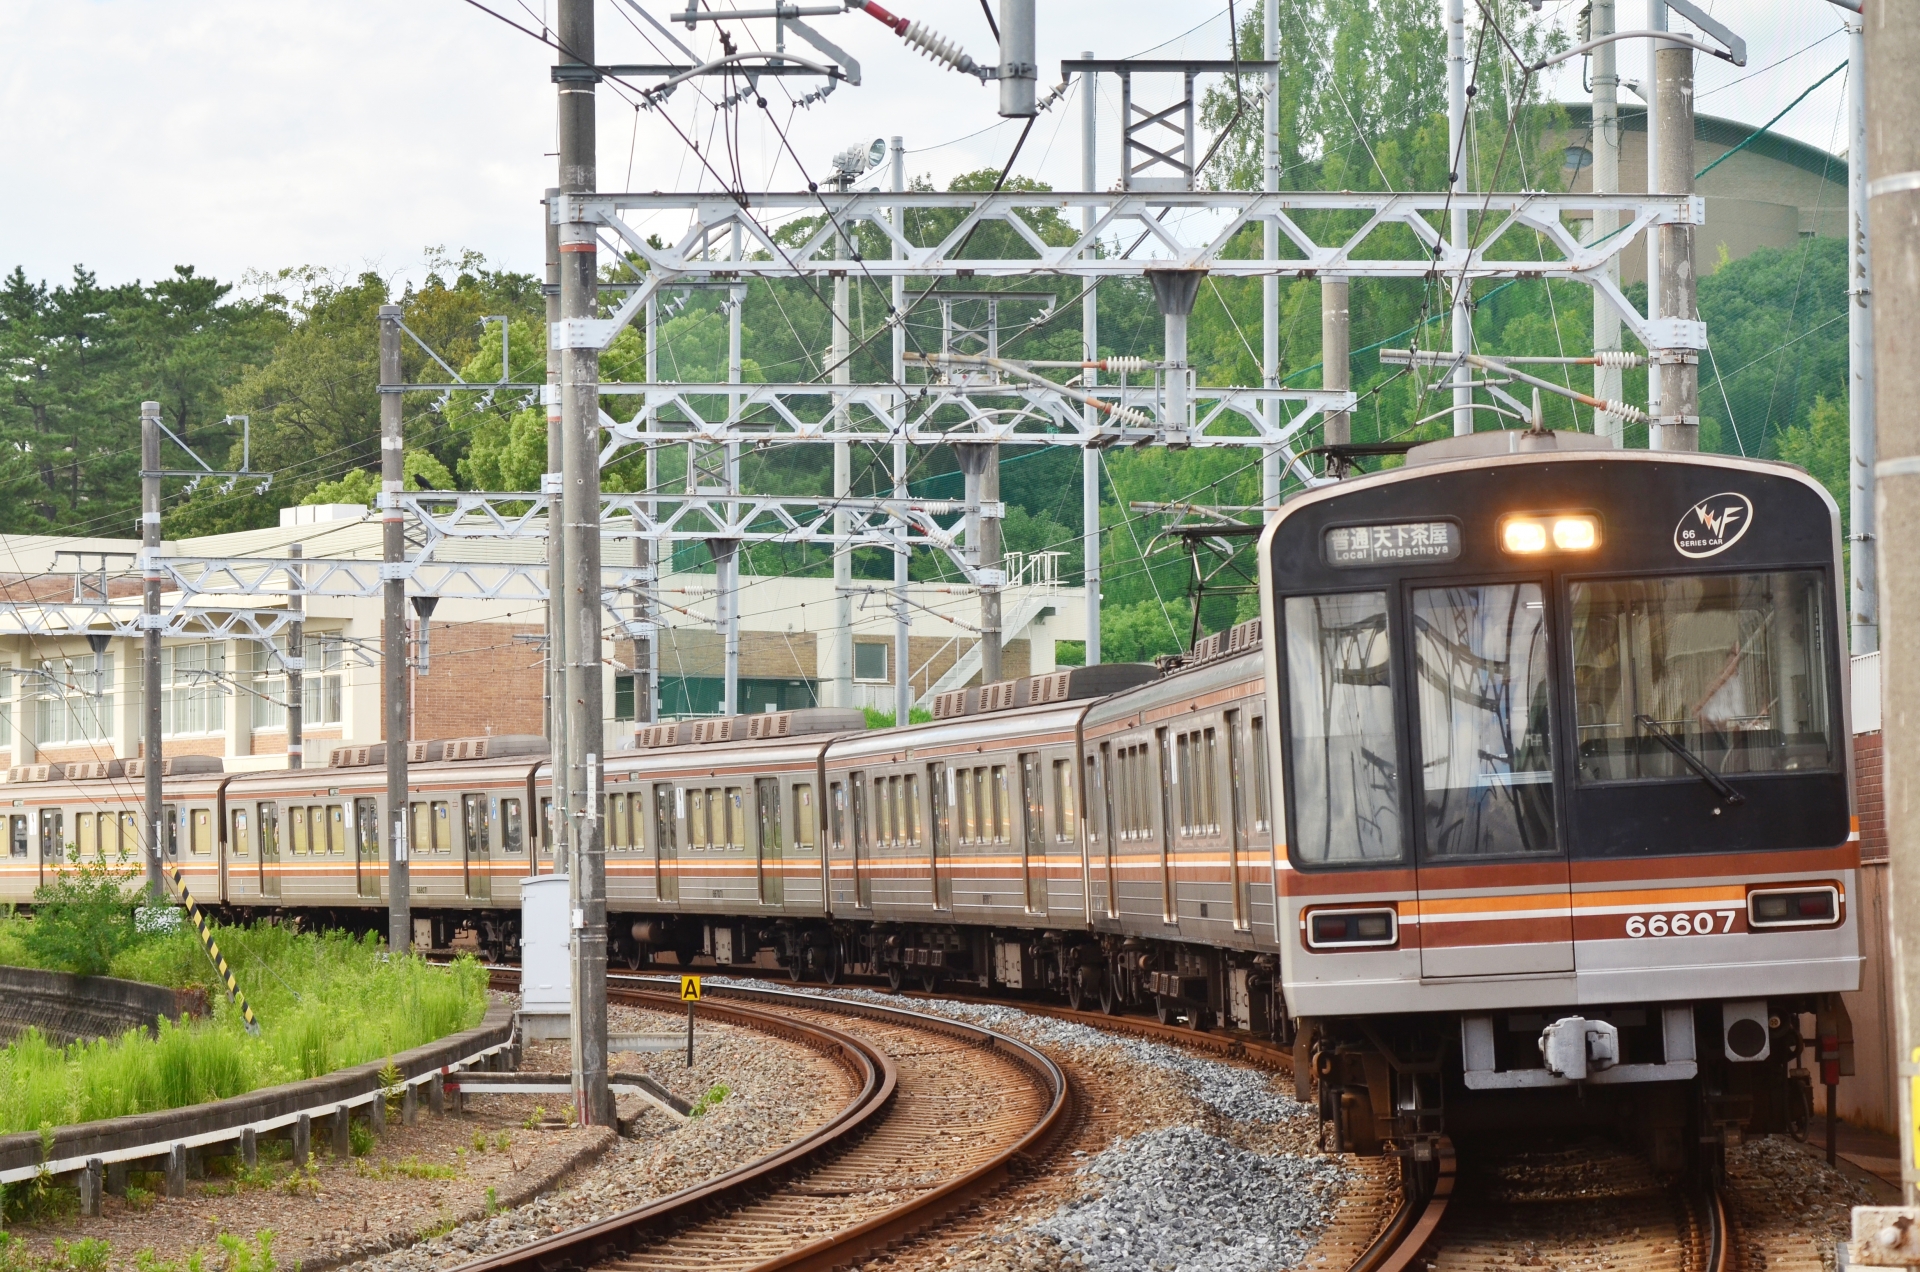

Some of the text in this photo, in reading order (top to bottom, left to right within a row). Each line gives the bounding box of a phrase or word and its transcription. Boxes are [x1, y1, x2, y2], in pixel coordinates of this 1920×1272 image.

[1332, 522, 1448, 550] 普通 天下茶屋
[1680, 538, 1723, 548] SERIES CAR
[1682, 529, 1696, 539] 66
[1335, 545, 1449, 561] Local Tengachaya
[1625, 910, 1736, 938] 66607
[683, 978, 698, 999] A
